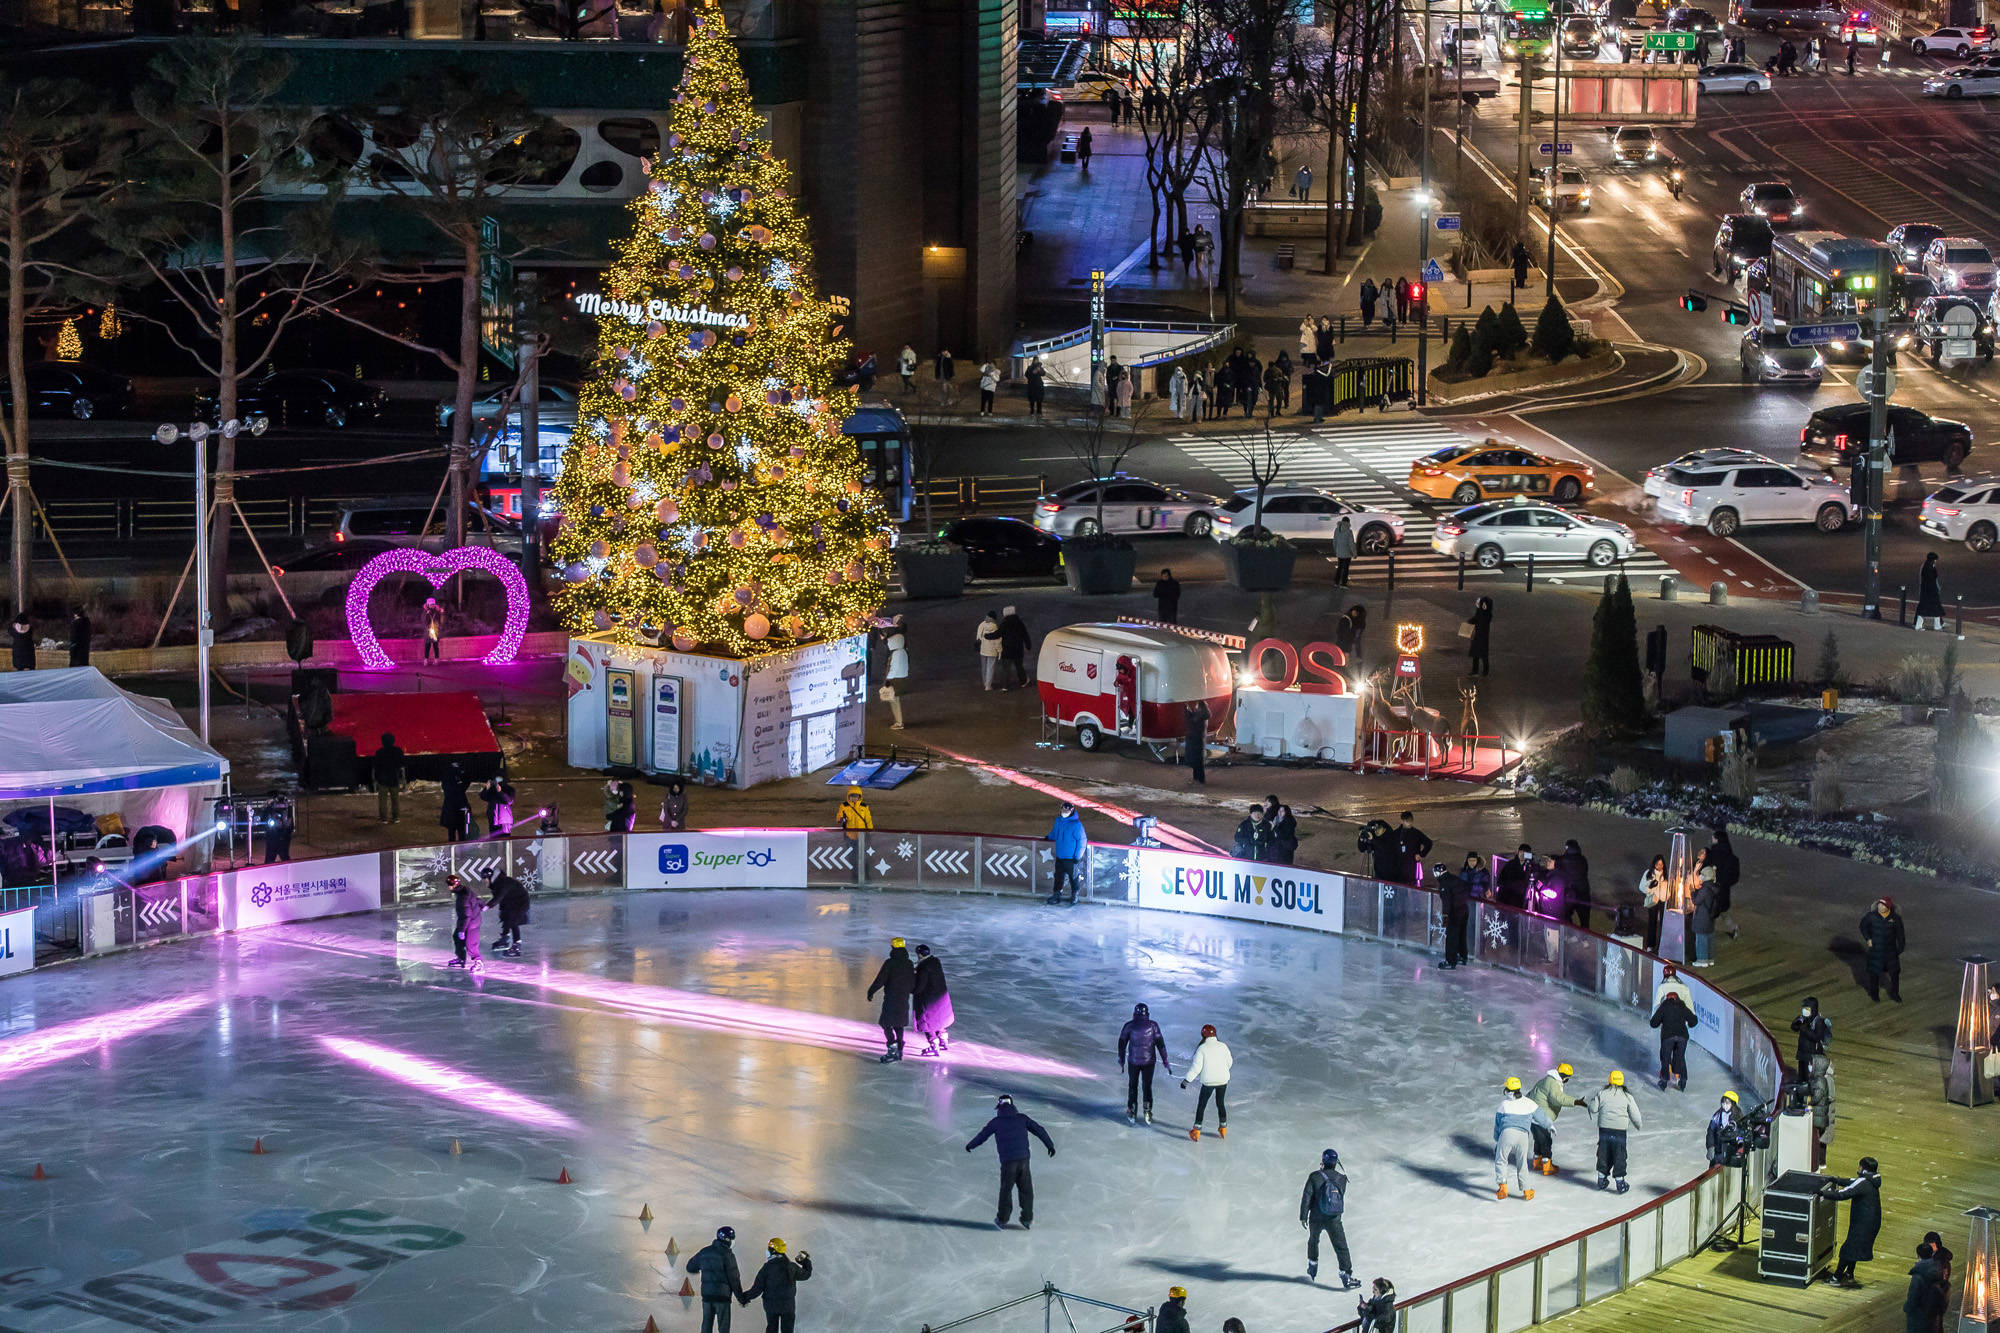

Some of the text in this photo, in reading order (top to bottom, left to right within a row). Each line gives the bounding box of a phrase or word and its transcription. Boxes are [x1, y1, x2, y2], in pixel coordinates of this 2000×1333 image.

[1655, 37, 1685, 47] 시청
[575, 293, 750, 328] Merry Christmas
[1846, 328, 1857, 337] 100
[1136, 507, 1174, 530] UT
[692, 851, 745, 869] Super
[274, 877, 347, 896] 서울특별시체육회
